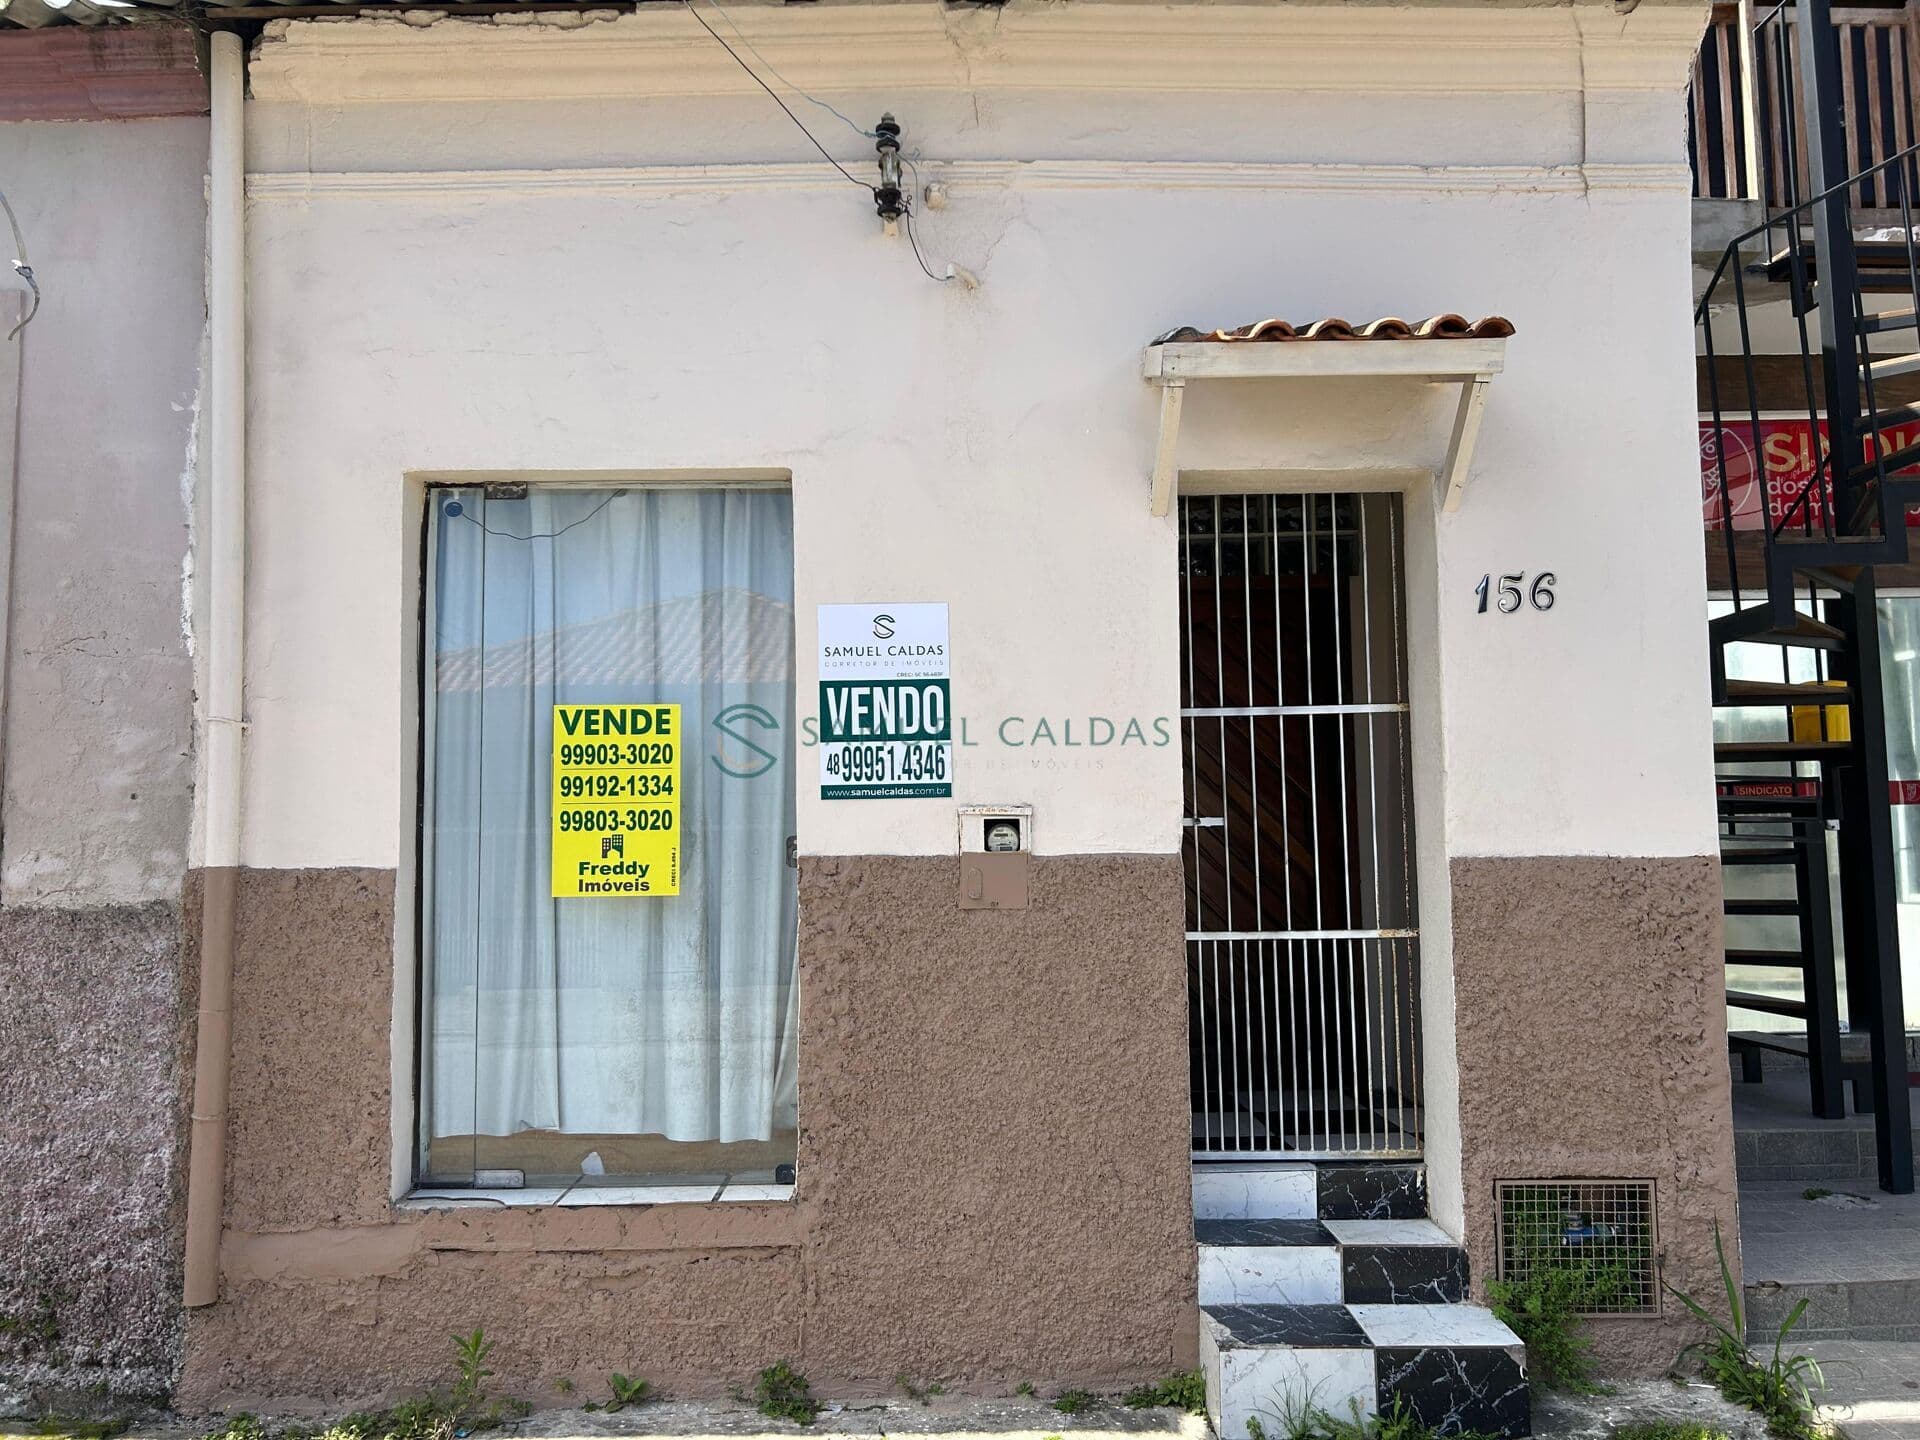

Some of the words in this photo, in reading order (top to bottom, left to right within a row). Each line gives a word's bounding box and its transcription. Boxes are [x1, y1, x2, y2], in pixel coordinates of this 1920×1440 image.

[1474, 570, 1556, 613] 156
[824, 646, 882, 657] SAMUEL
[887, 645, 943, 656] CALDAS
[824, 660, 878, 668] CORRETOR
[826, 684, 946, 736] VENDO
[559, 708, 671, 736] VENDE
[560, 743, 674, 766] 99903-3020
[826, 753, 840, 775] 48
[842, 744, 946, 782] 99951.4346
[560, 774, 674, 797] 99192-1334
[826, 787, 946, 797] www.samuelcaldas.com.br
[1739, 785, 1793, 796] SINDICATO
[559, 809, 673, 832] 99803-3020
[578, 861, 650, 878] Freddy
[578, 878, 650, 892] Imóveis
